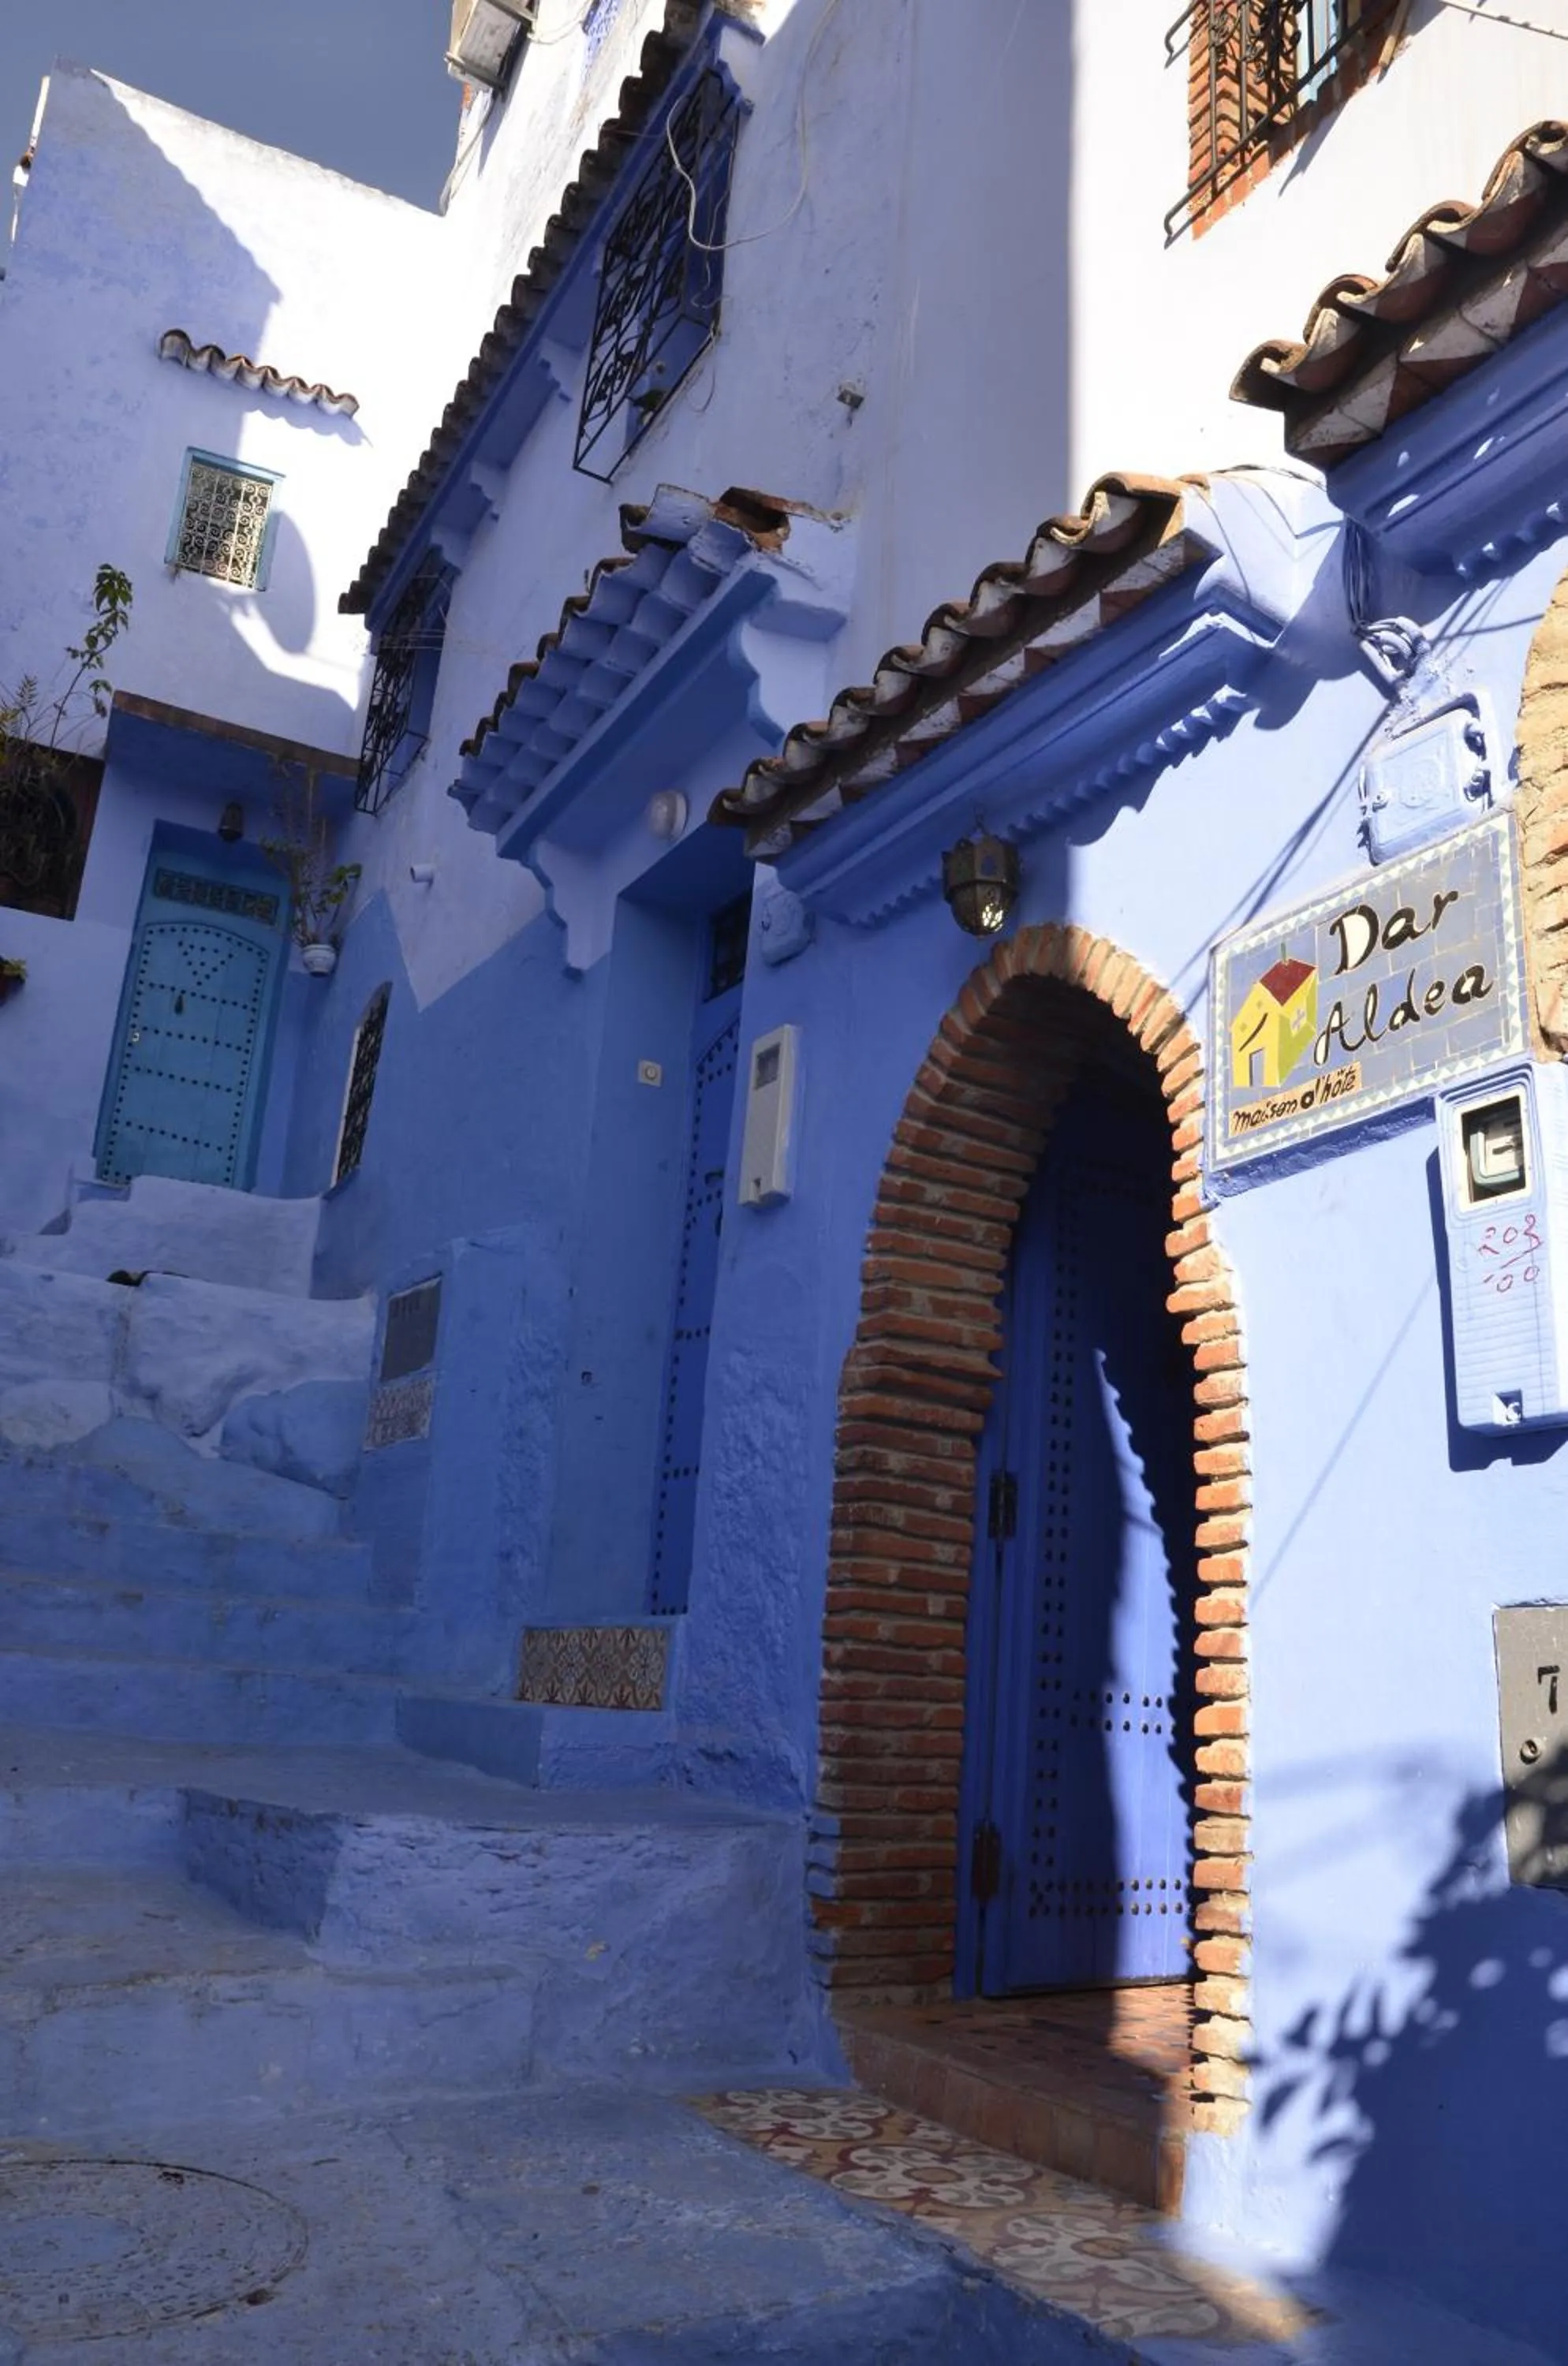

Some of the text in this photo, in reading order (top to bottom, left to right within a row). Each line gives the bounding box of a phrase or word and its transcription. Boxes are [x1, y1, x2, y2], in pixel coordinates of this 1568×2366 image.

[1330, 890, 1459, 976] Dar
[1314, 964, 1493, 1065] Aldea
[1233, 1099, 1297, 1132] maison
[1537, 1666, 1561, 1715] 7
